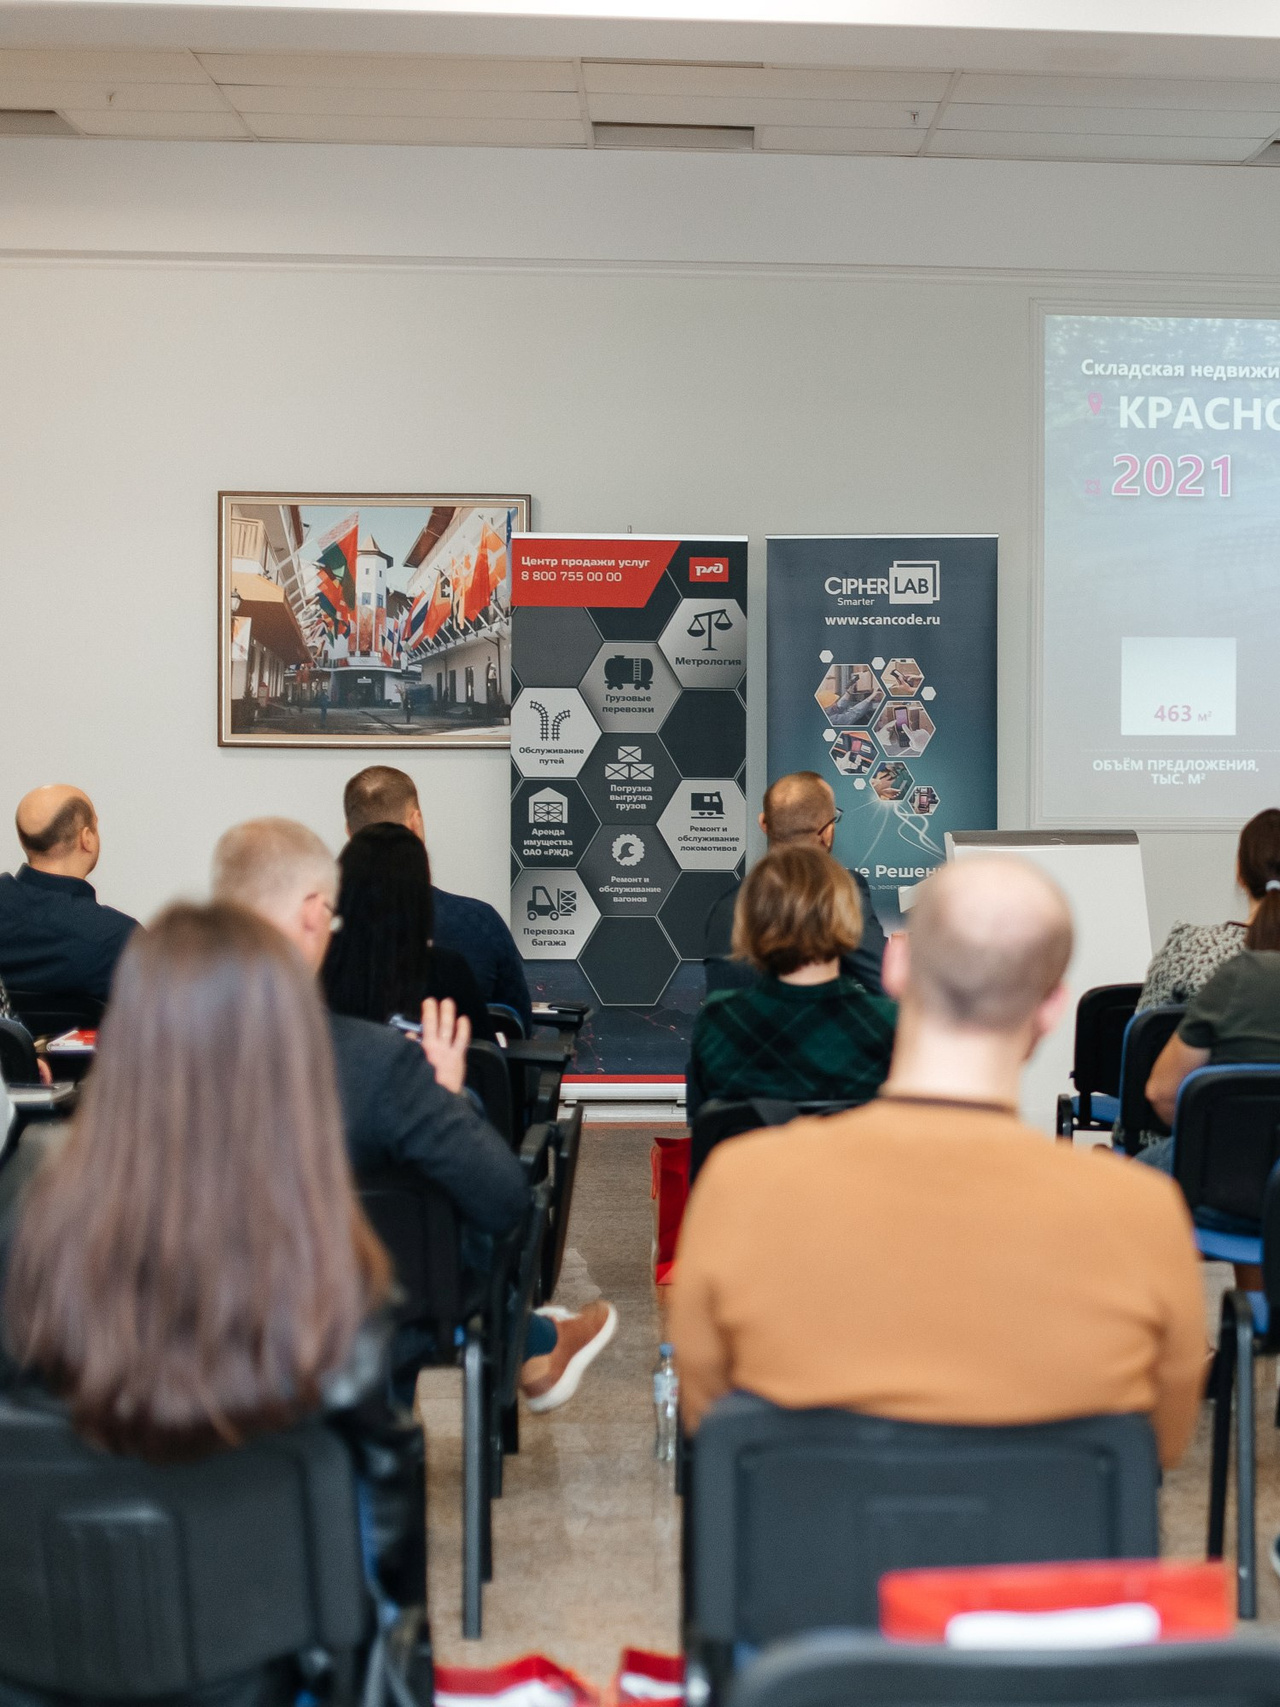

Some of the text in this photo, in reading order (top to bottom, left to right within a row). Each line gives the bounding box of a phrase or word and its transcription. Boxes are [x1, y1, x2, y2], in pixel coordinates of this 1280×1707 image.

[1081, 359, 1185, 378] Складская
[1111, 454, 1232, 497] 2021
[521, 556, 650, 569] Центр продажи услуг
[521, 571, 622, 582] 8 800 755 00 00
[837, 597, 875, 606] Smarter
[825, 614, 940, 626] www.scancode.ru
[675, 657, 742, 667] Метрология
[605, 694, 652, 704] Грузовые
[602, 706, 655, 715] перевозки
[1154, 705, 1193, 722] 463
[519, 747, 585, 756] Обслуживание
[539, 757, 565, 766] путей
[1093, 757, 1260, 774] ОБЪЁМ ПРЕДЛОЖЕНИЯ,
[1151, 774, 1184, 785] ТЫС.
[610, 784, 652, 794] Погрузка
[609, 794, 653, 803] выгрузка
[616, 803, 647, 811] грузов
[532, 828, 566, 838] Аренда
[689, 825, 720, 833] Ремонт
[523, 839, 574, 848] имущества
[677, 835, 740, 844] обслуживание
[523, 848, 574, 858] ОАО «РЖД»
[680, 845, 738, 853] локомотивов
[875, 864, 942, 878] Решен
[611, 876, 642, 884] Ремонт
[598, 886, 662, 895] обслуживание
[523, 928, 575, 938] Перевозка
[531, 938, 567, 947] багажа
